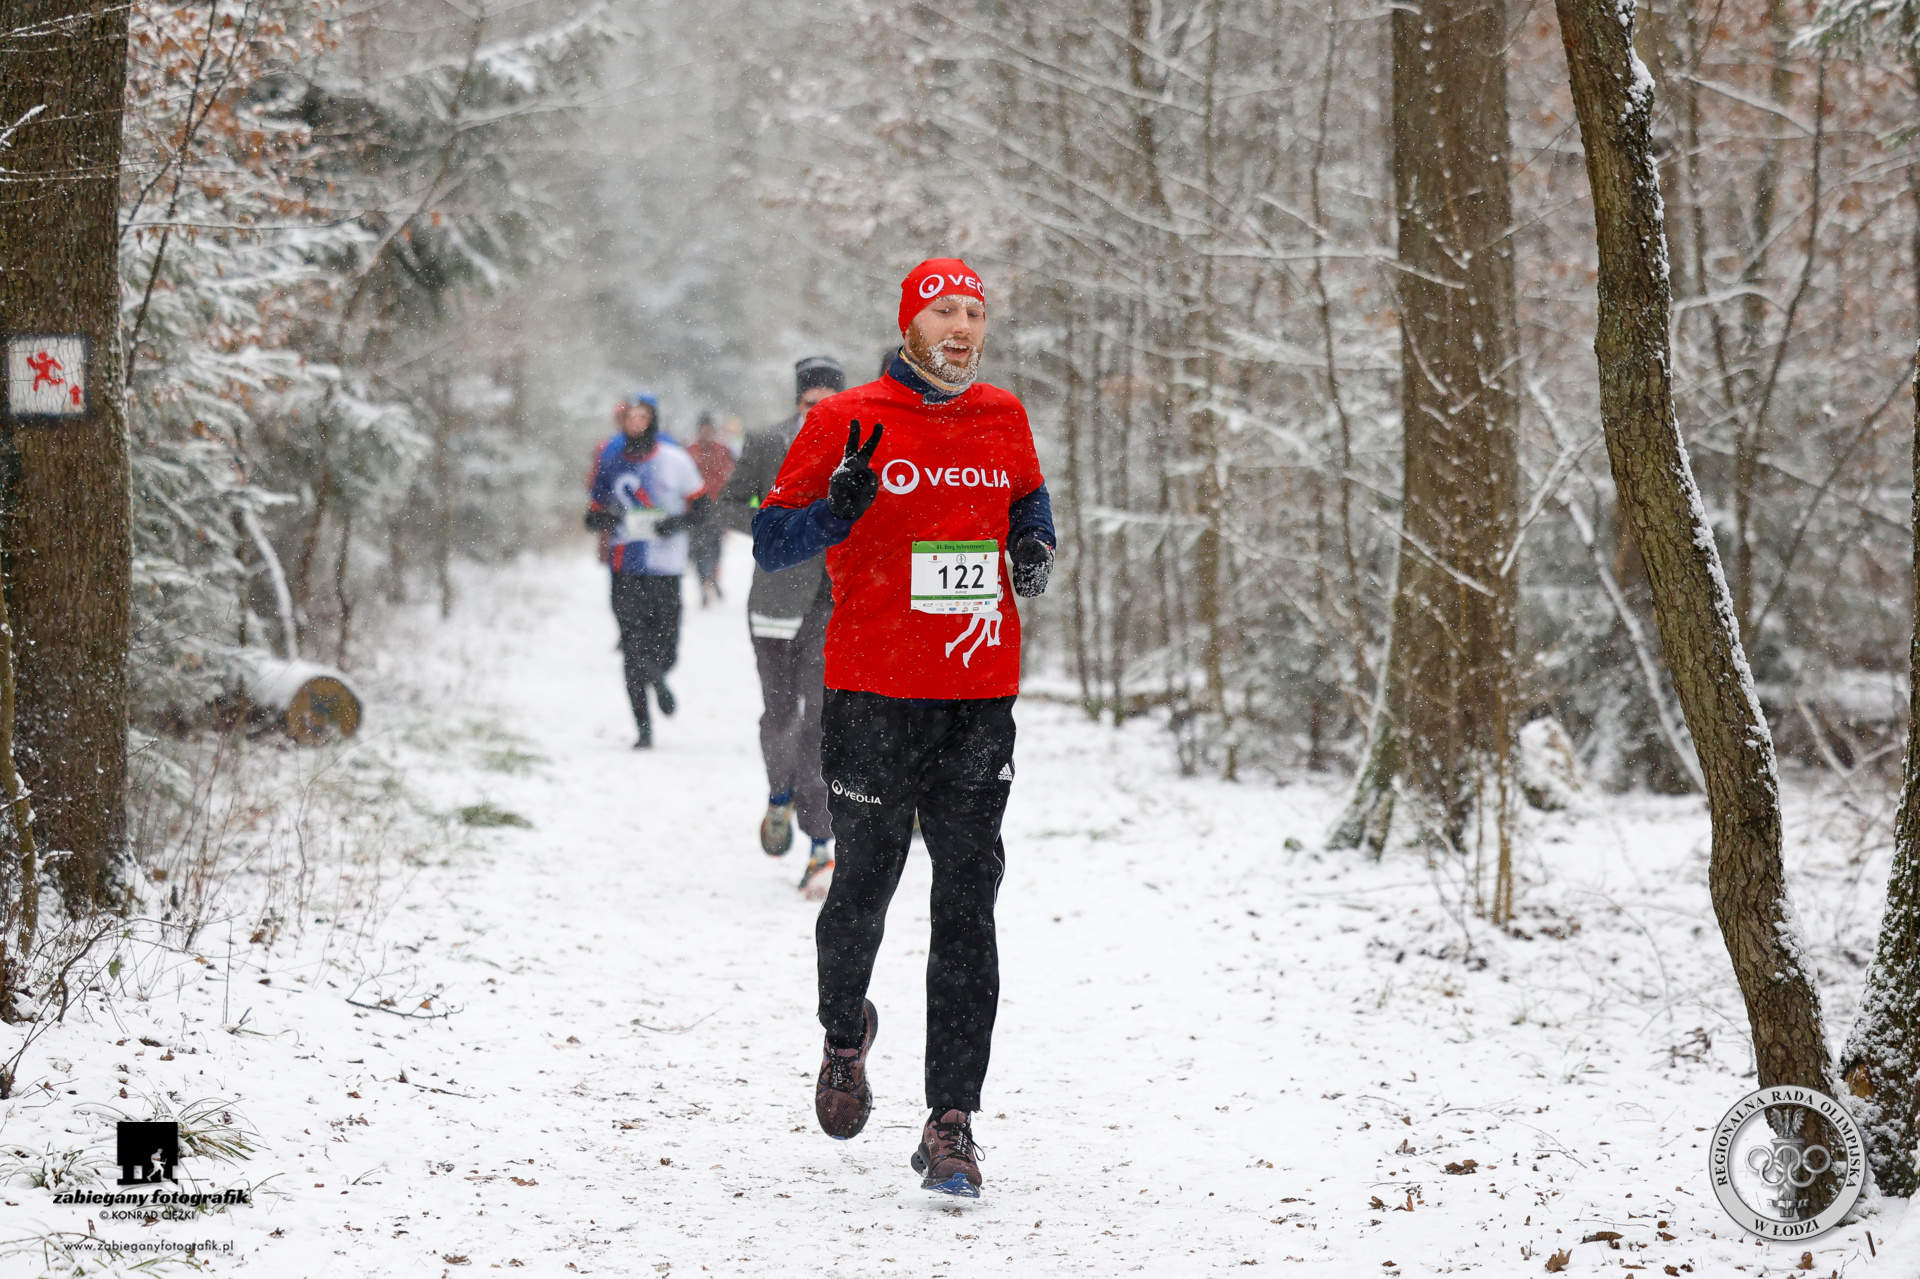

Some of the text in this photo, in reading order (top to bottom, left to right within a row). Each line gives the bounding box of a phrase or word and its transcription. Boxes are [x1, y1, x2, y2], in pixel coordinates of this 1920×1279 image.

[924, 467, 1010, 488] VEOLIA
[938, 564, 984, 589] 122
[843, 790, 882, 805] VEOLIA
